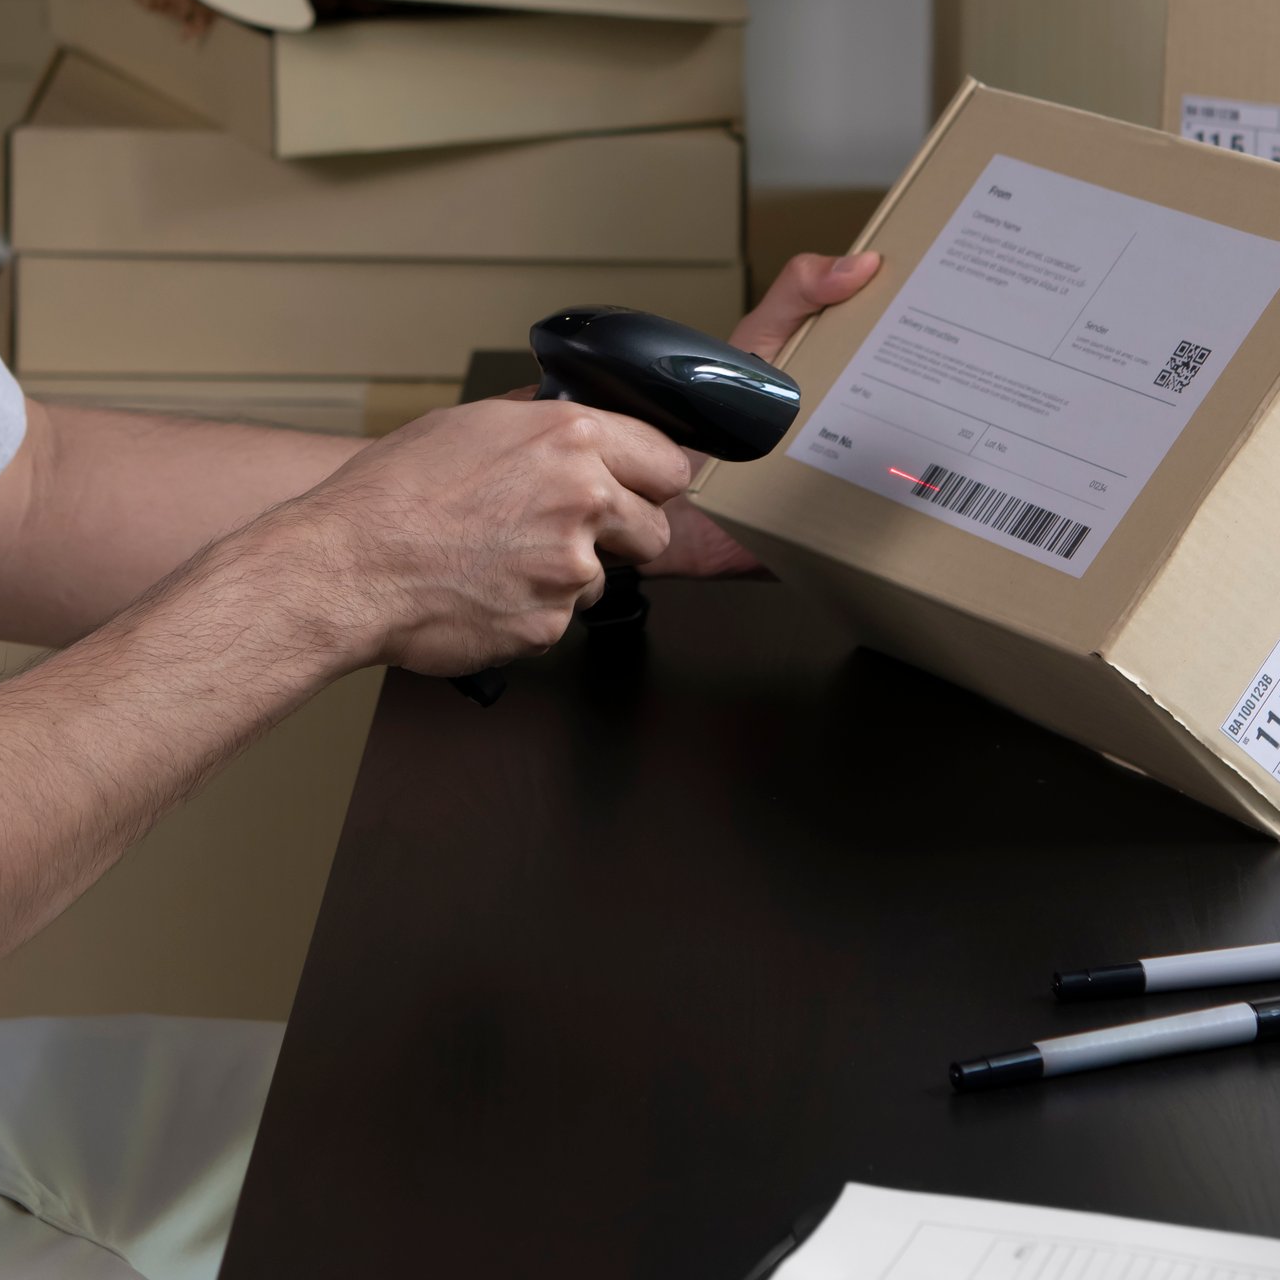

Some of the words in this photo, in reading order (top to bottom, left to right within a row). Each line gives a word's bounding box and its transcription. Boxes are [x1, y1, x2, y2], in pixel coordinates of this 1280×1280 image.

[989, 186, 1013, 199] From
[1085, 321, 1109, 334] Sender
[819, 428, 840, 441] Item
[985, 439, 996, 448] Lot
[1229, 673, 1272, 735] BA100123B
[1242, 736, 1250, 745] US
